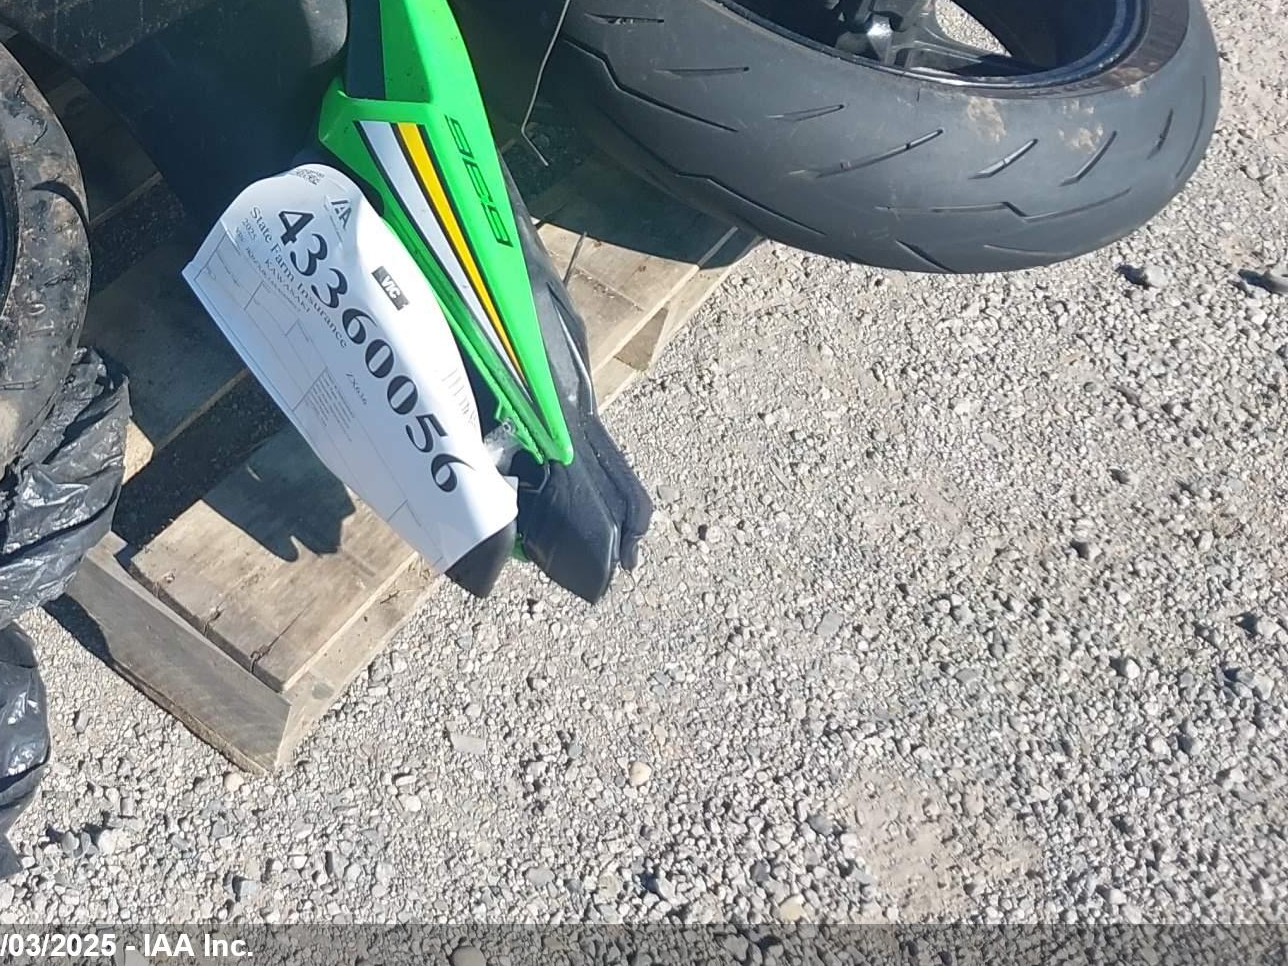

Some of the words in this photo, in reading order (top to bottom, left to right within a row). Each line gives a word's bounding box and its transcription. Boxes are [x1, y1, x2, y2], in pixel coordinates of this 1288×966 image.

[444, 114, 514, 247] 636
[251, 207, 273, 243] State
[270, 242, 295, 283] Farm
[297, 282, 348, 348] Insurance
[264, 258, 311, 313] KAWASAKI
[380, 275, 401, 300] VIC
[277, 209, 477, 494] 43360056
